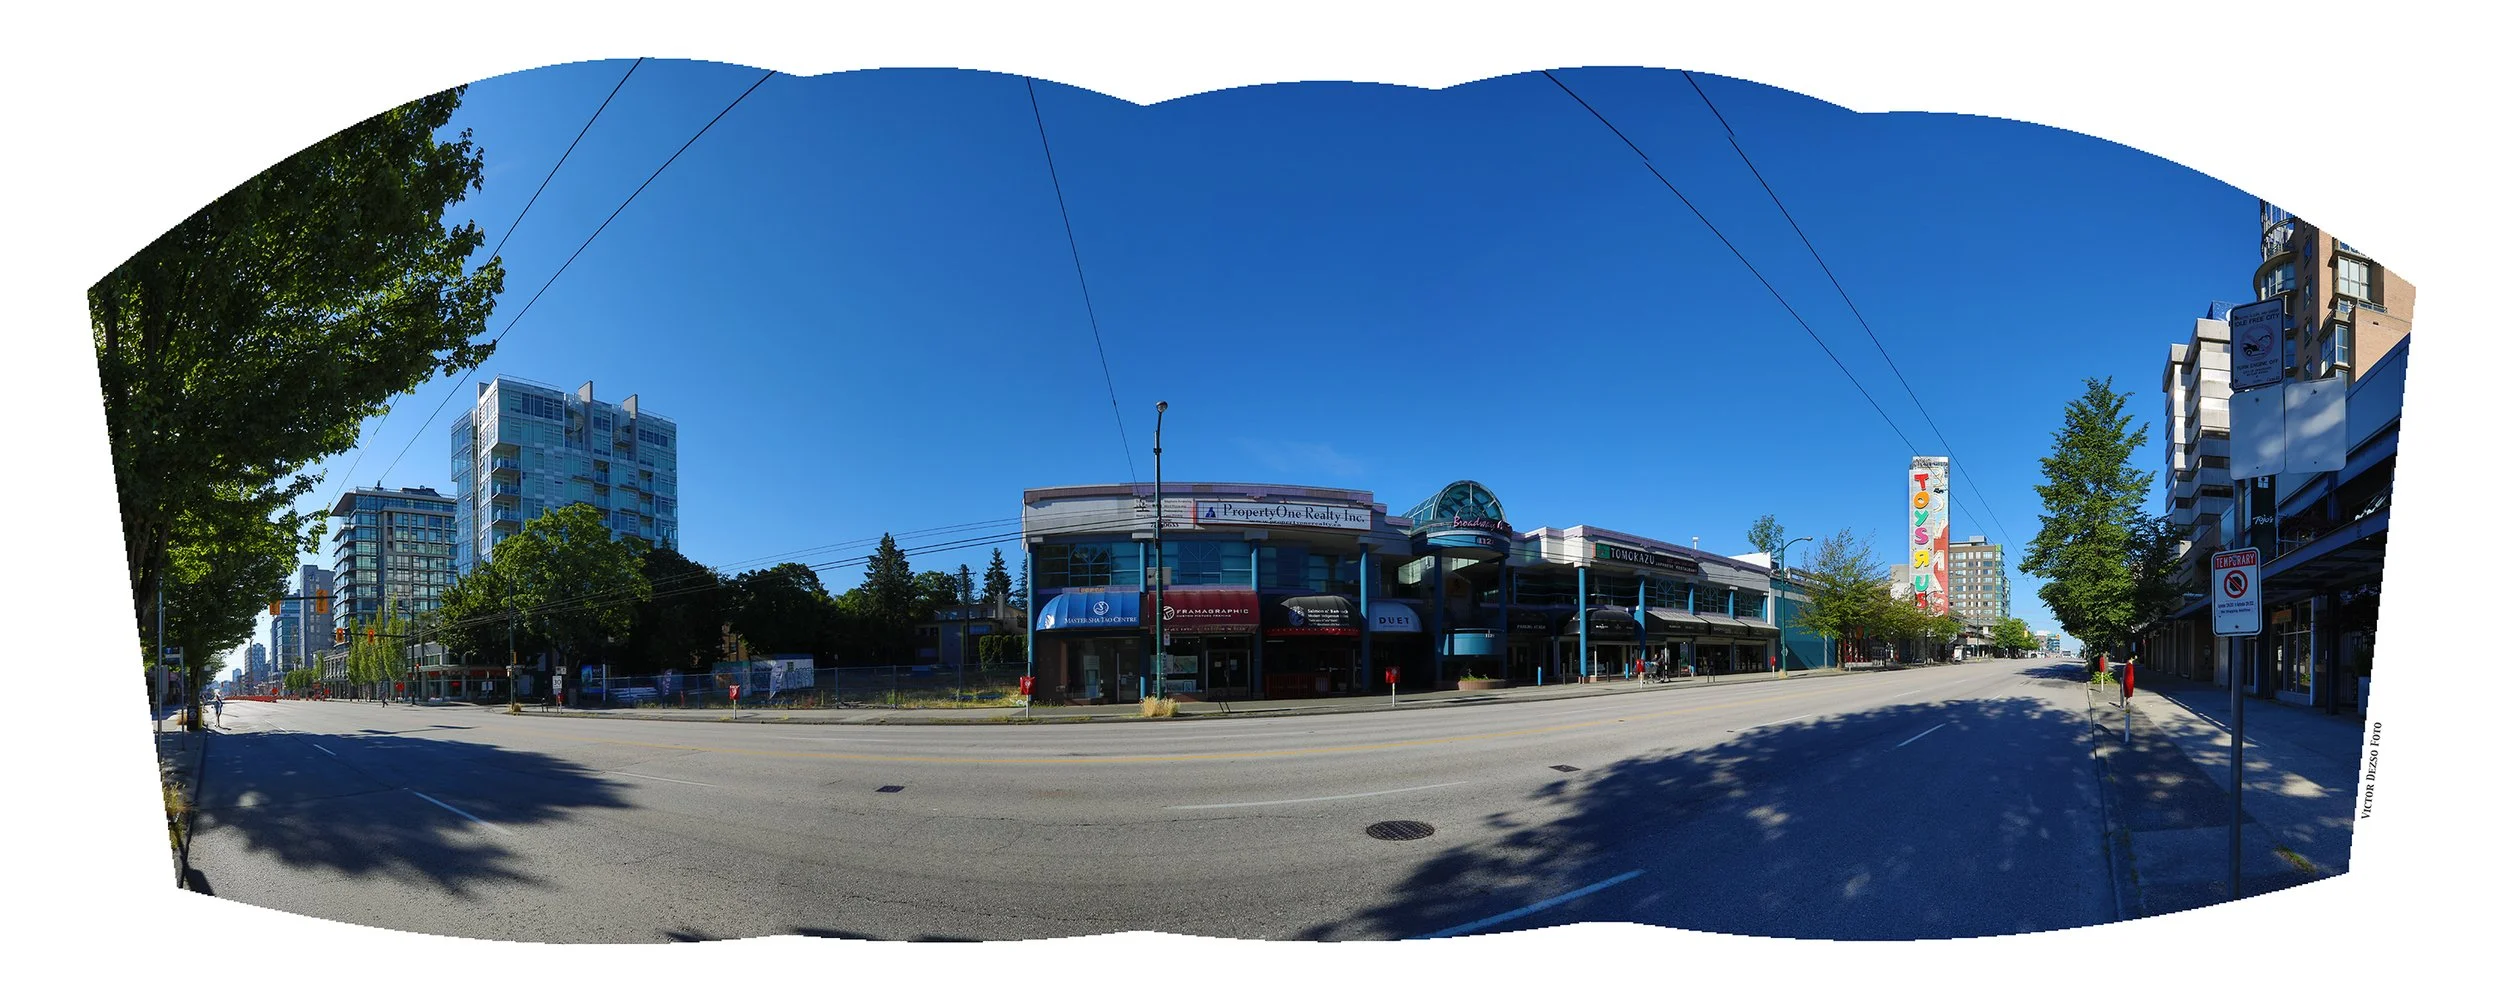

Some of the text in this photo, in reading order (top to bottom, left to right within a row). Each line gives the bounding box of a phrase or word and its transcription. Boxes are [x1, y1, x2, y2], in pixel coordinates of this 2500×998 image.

[2249, 316, 2265, 325] FREE
[2266, 312, 2280, 320] CITY
[1223, 503, 1365, 523] PropertyOne Realty Inc.
[1914, 473, 1929, 545] TOYS
[1453, 515, 1496, 531] Broadway
[2252, 514, 2274, 525] Tojo's
[1610, 547, 1655, 565] TOMOKAZU
[1914, 574, 1929, 609] US
[1379, 616, 1410, 625] DUET
